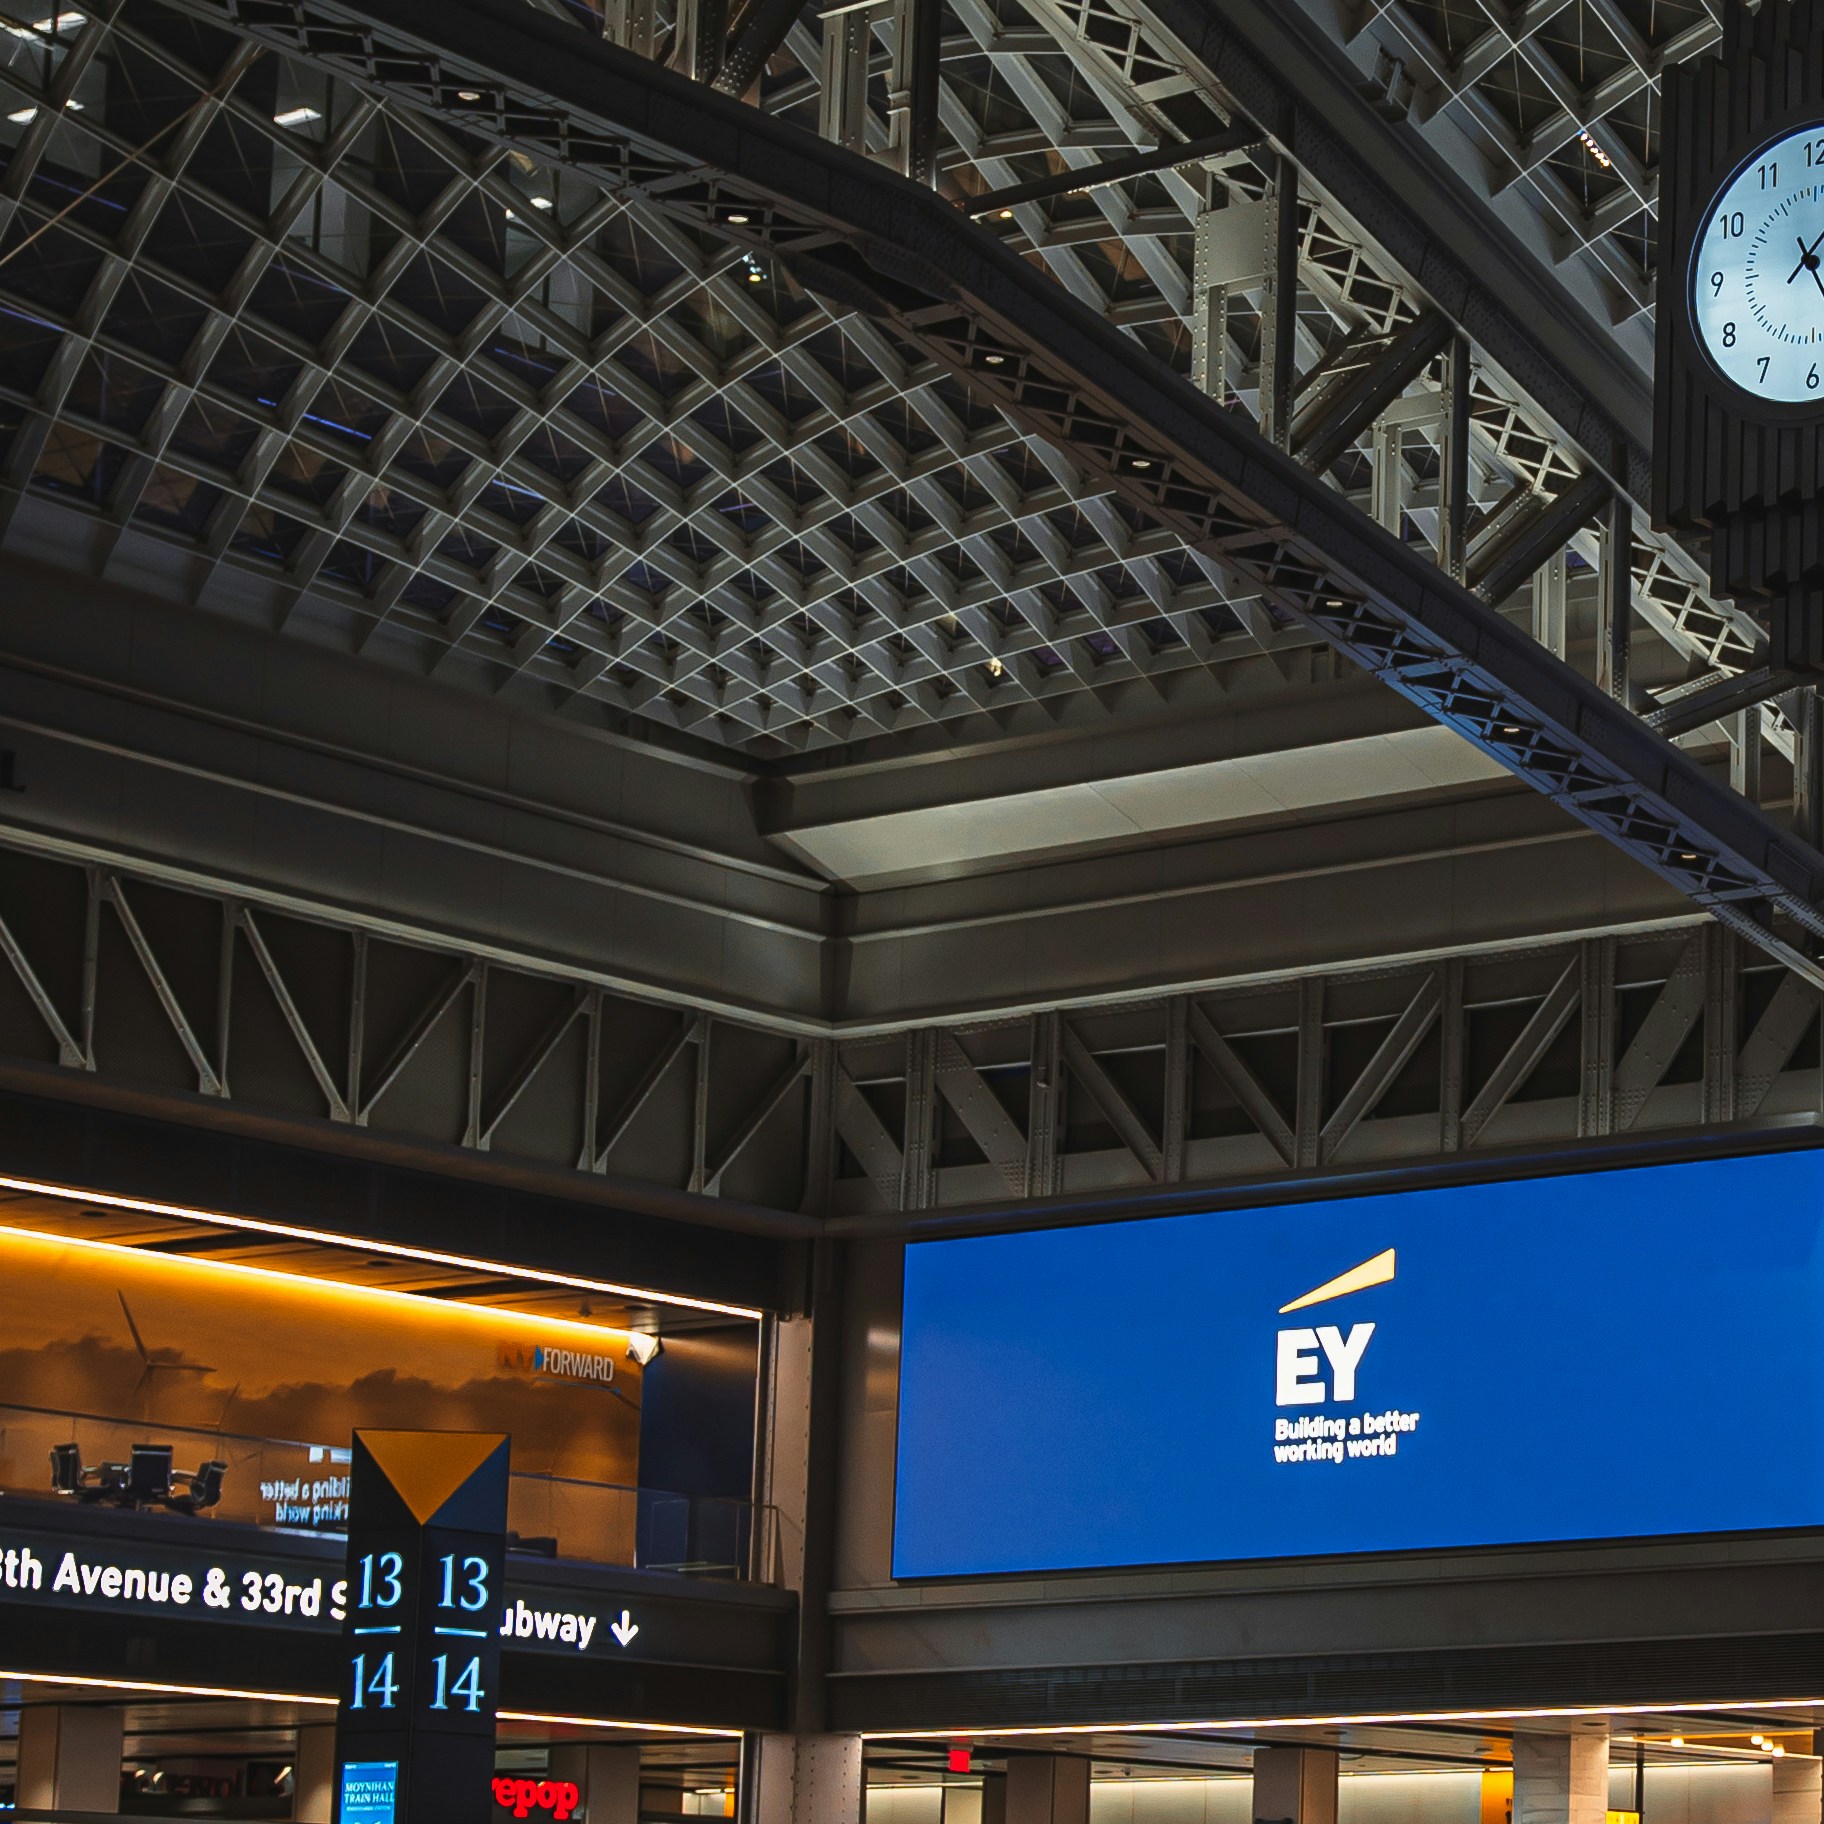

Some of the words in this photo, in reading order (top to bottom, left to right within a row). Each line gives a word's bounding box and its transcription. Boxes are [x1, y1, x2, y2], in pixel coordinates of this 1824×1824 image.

[1757, 162, 1778, 190] 11
[1719, 211, 1744, 239] 10
[1710, 271, 1724, 297] 9
[1722, 322, 1736, 347] 8
[1756, 356, 1770, 383] 7
[1805, 362, 1819, 389] 6
[542, 1347, 615, 1382] FORWARD
[1276, 1322, 1376, 1407] EY
[1275, 1415, 1346, 1441] Building
[1348, 1417, 1361, 1435] a
[1363, 1410, 1420, 1435] better
[1273, 1438, 1345, 1464] working
[1347, 1433, 1397, 1458] world
[357, 1551, 403, 1609] 13
[437, 1553, 489, 1612] 13
[0, 1548, 43, 1590] th
[53, 1552, 193, 1605] Avenue
[202, 1567, 231, 1609] &
[240, 1571, 322, 1617] 33rd
[500, 1600, 597, 1650] ubway
[350, 1652, 400, 1710] 14
[430, 1654, 485, 1712] 14
[344, 1793, 371, 1804] TRAIN
[372, 1792, 395, 1803] HALL
[345, 1781, 395, 1792] MOYNIHAN
[492, 1778, 579, 1820] epop
